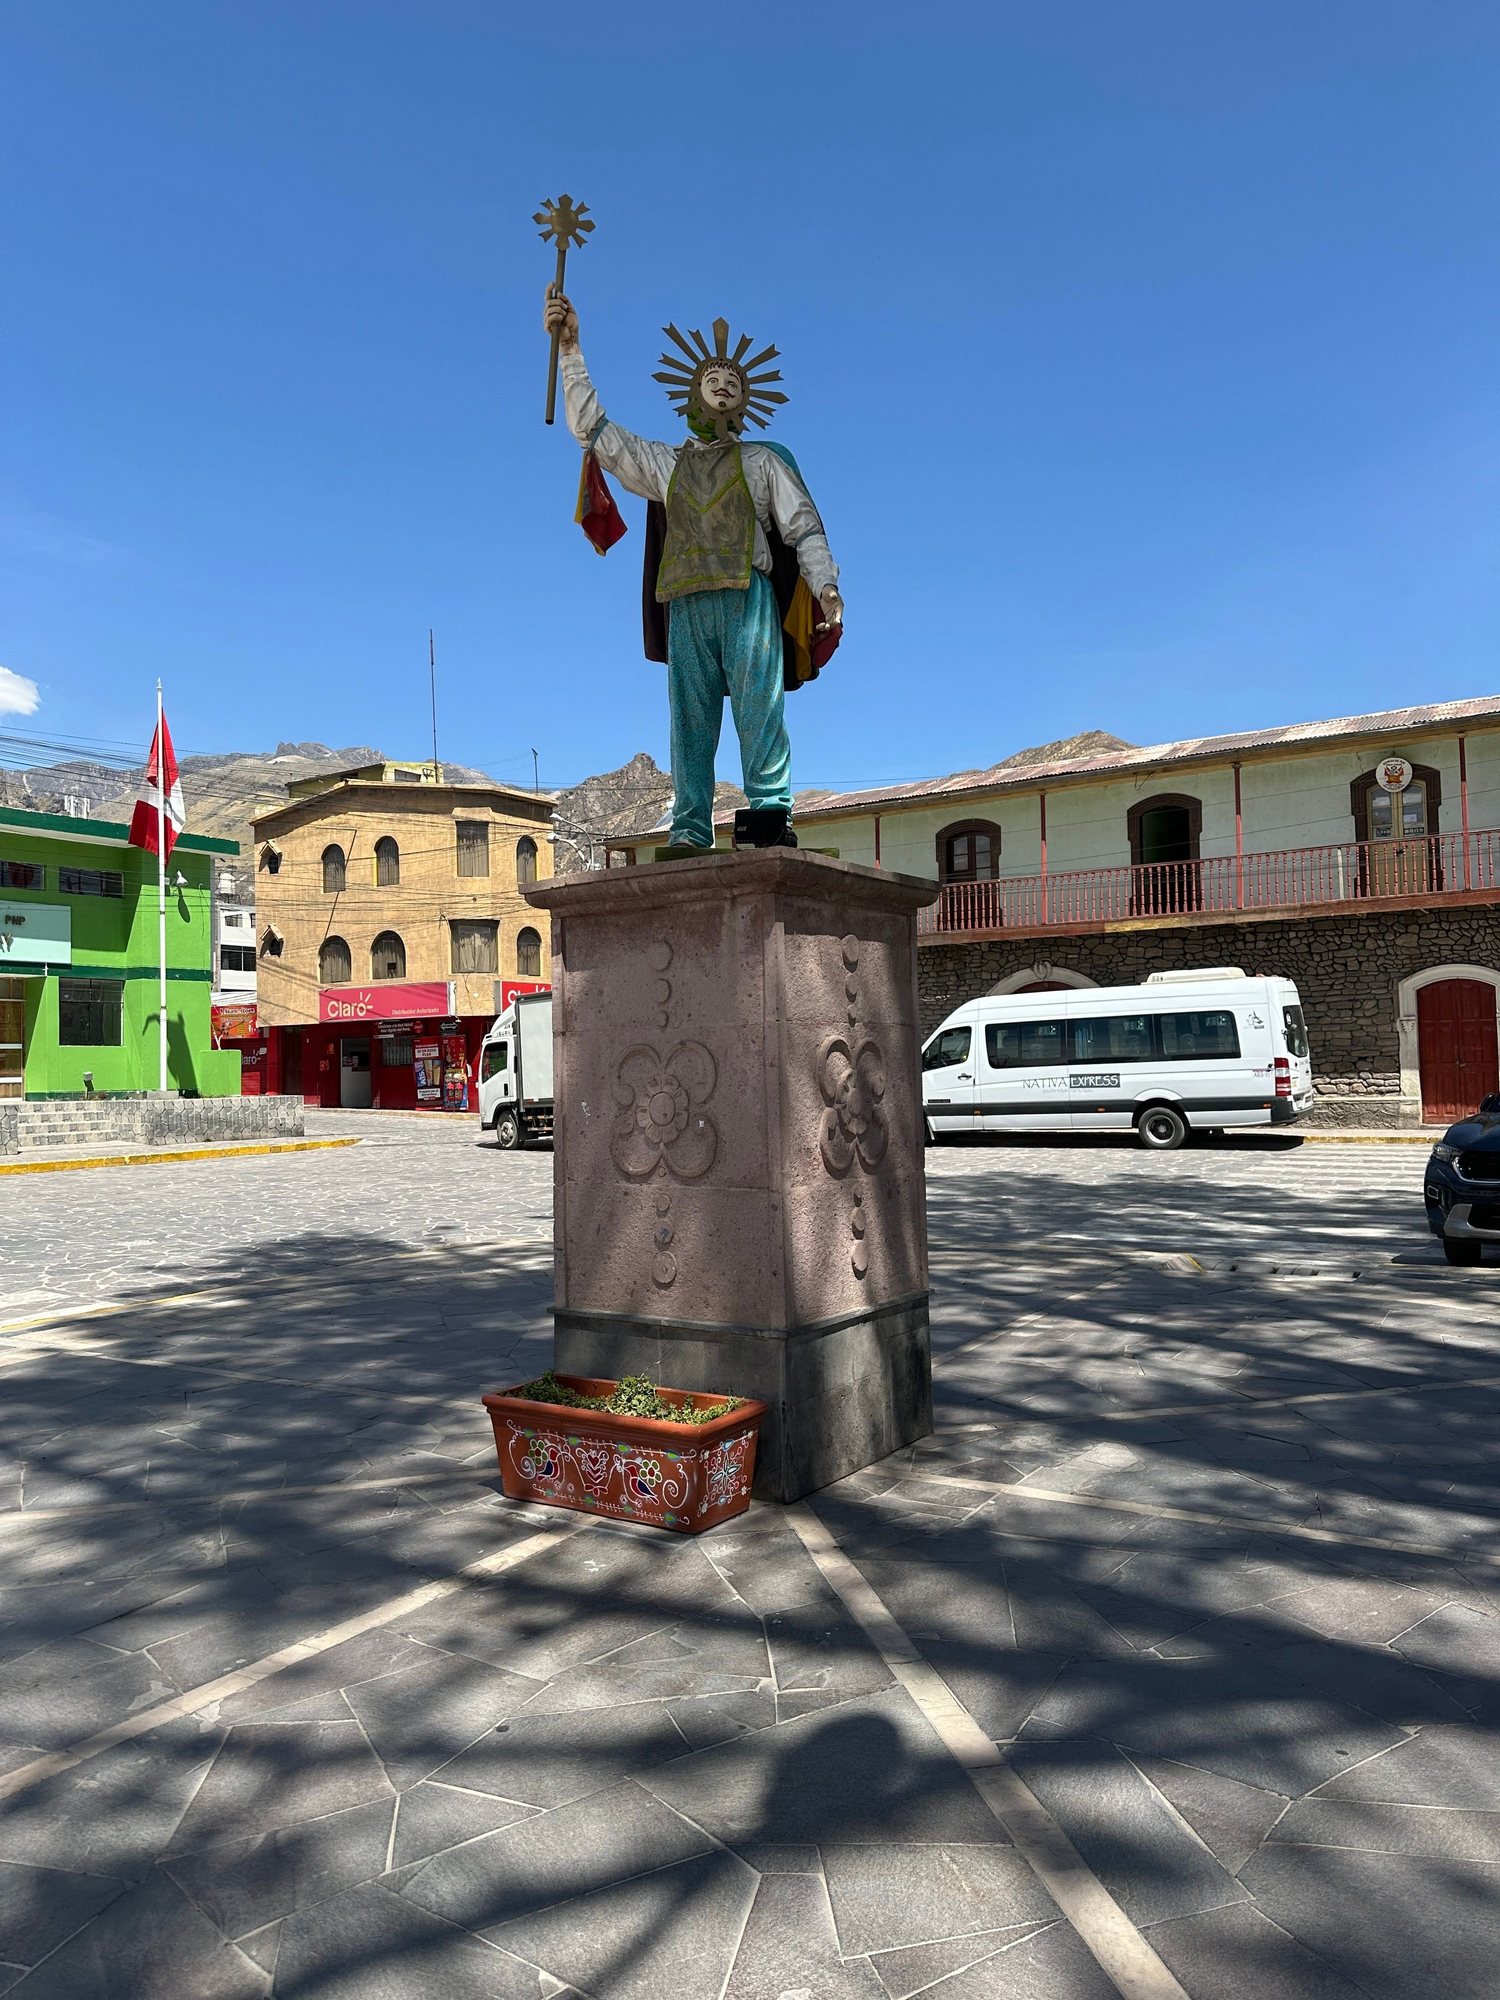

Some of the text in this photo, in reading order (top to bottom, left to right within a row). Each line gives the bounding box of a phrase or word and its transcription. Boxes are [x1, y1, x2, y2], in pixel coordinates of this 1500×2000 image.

[5, 915, 26, 926] PNP
[327, 1000, 367, 1018] Claro
[241, 1055, 257, 1065] laro
[1022, 1075, 1119, 1089] NATIVA EXPRESS
